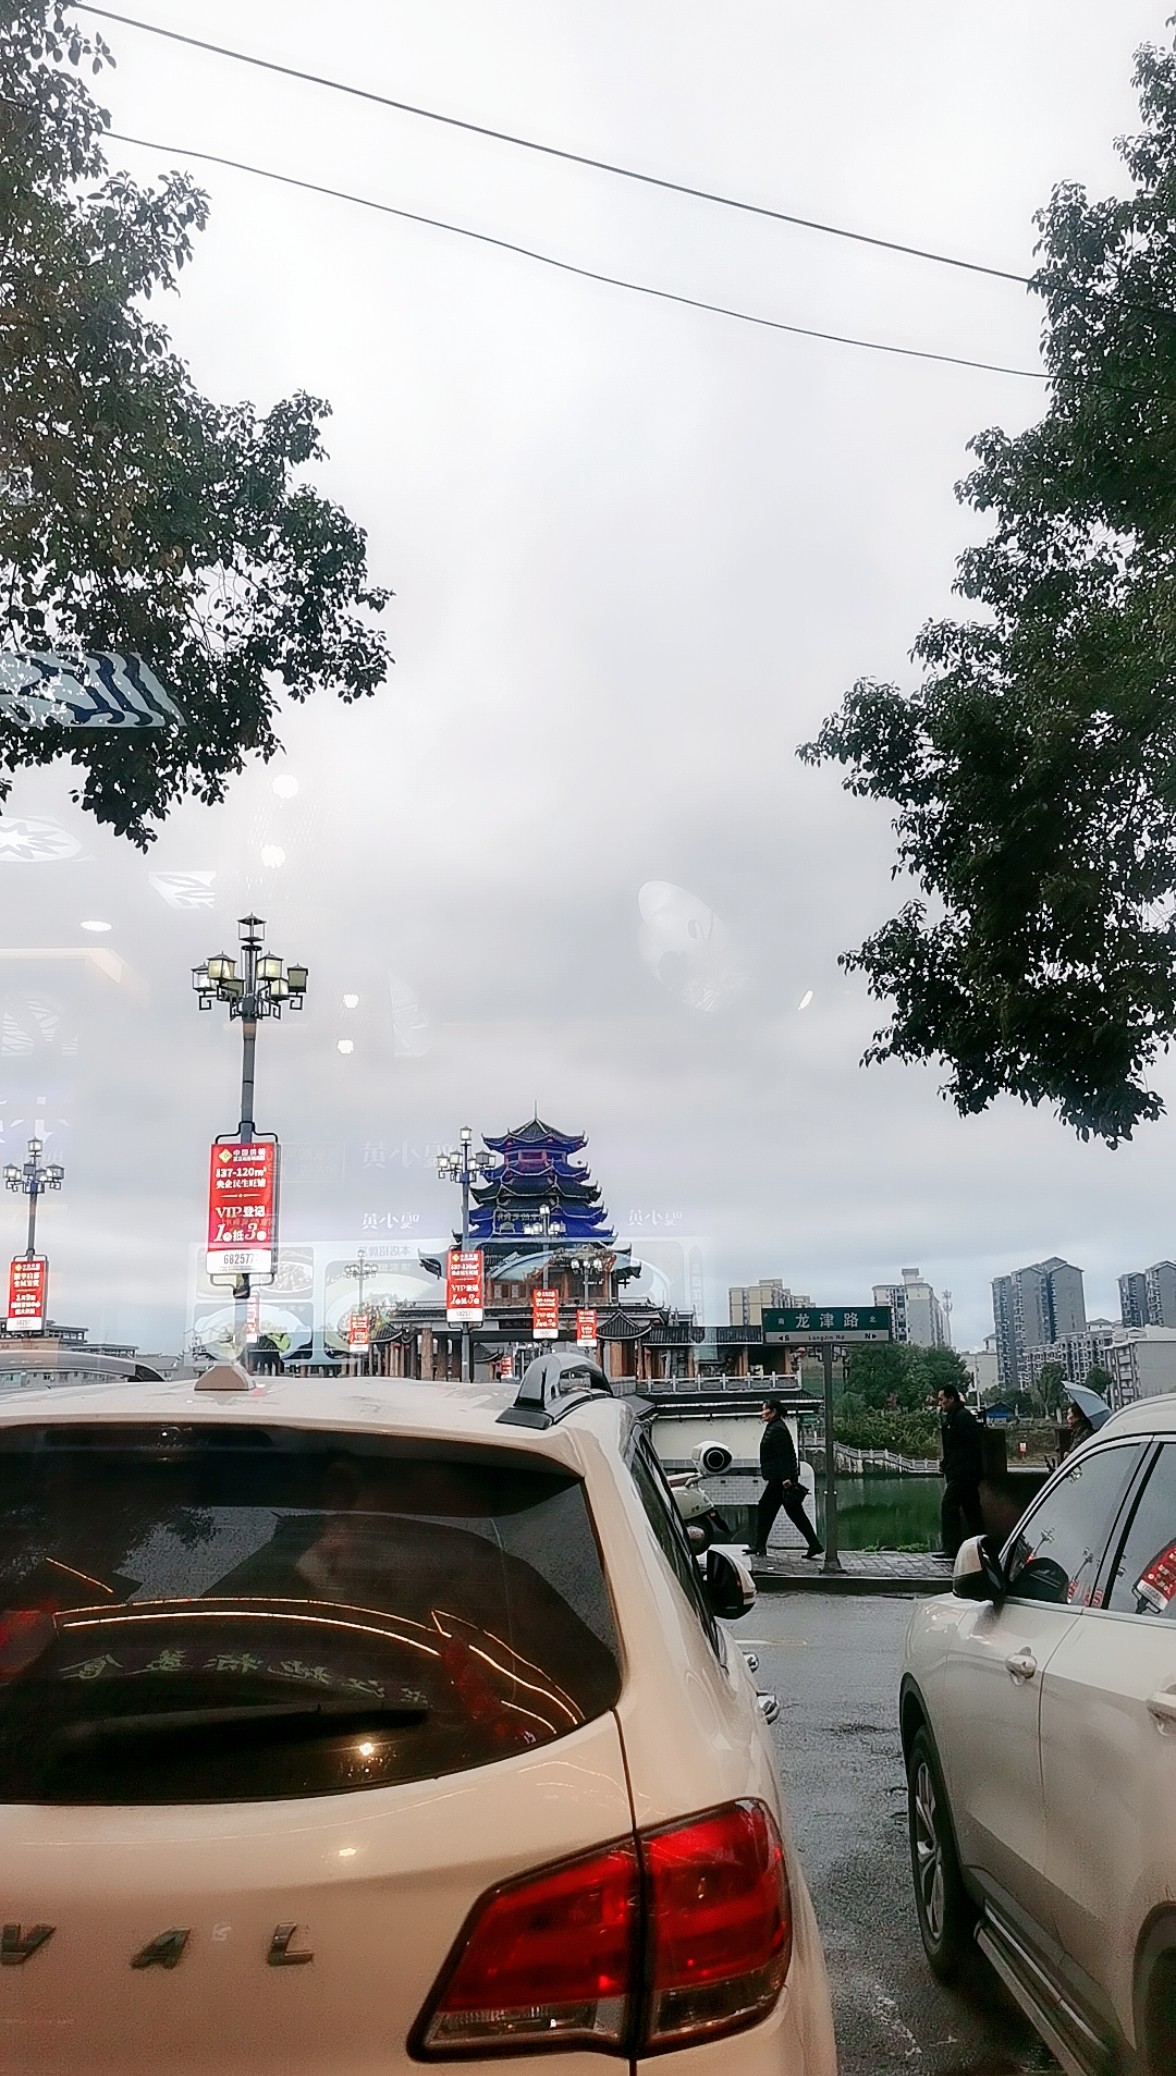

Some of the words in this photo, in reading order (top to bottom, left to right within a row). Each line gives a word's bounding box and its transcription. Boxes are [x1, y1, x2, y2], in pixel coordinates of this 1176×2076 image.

[213, 1223, 267, 1242] 1抵3
[795, 1312, 859, 1329] 龙津路
